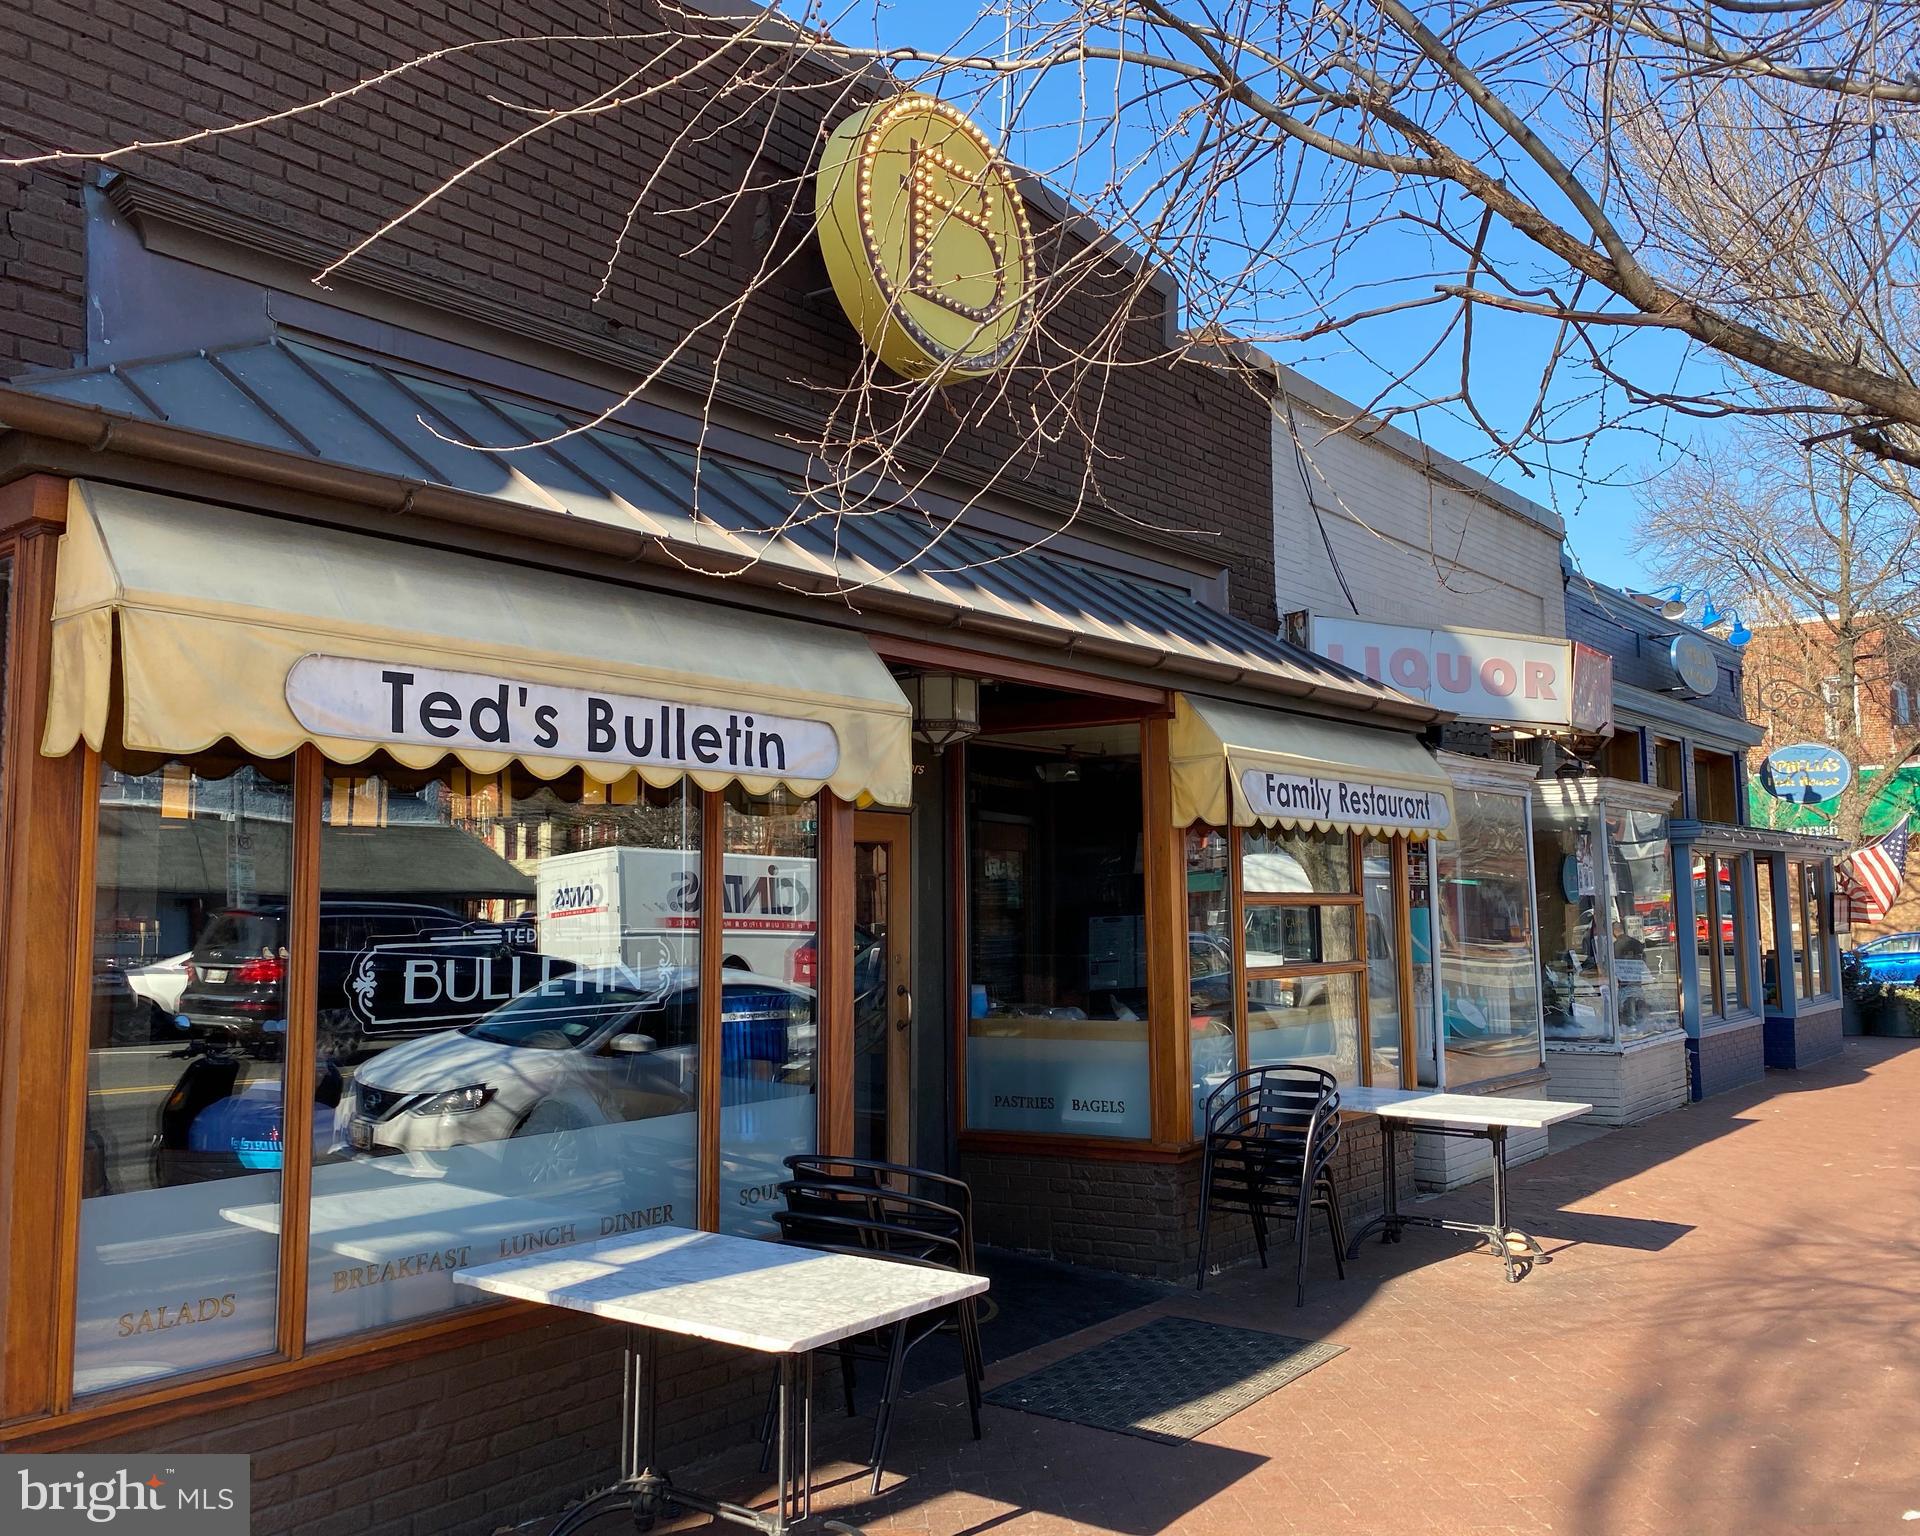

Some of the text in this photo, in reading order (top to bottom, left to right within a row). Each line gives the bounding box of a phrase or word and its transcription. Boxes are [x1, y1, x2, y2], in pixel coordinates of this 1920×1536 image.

[382, 670, 787, 771] Ted's Bulletin
[1265, 773, 1430, 820] Family Restaurant
[403, 952, 642, 1004] BULLETIN
[993, 1094, 1126, 1114] PASTRIES BAGELS
[332, 1204, 675, 1294] BREAKFAST LUNCH DINNER
[118, 1293, 237, 1338] SALADS
